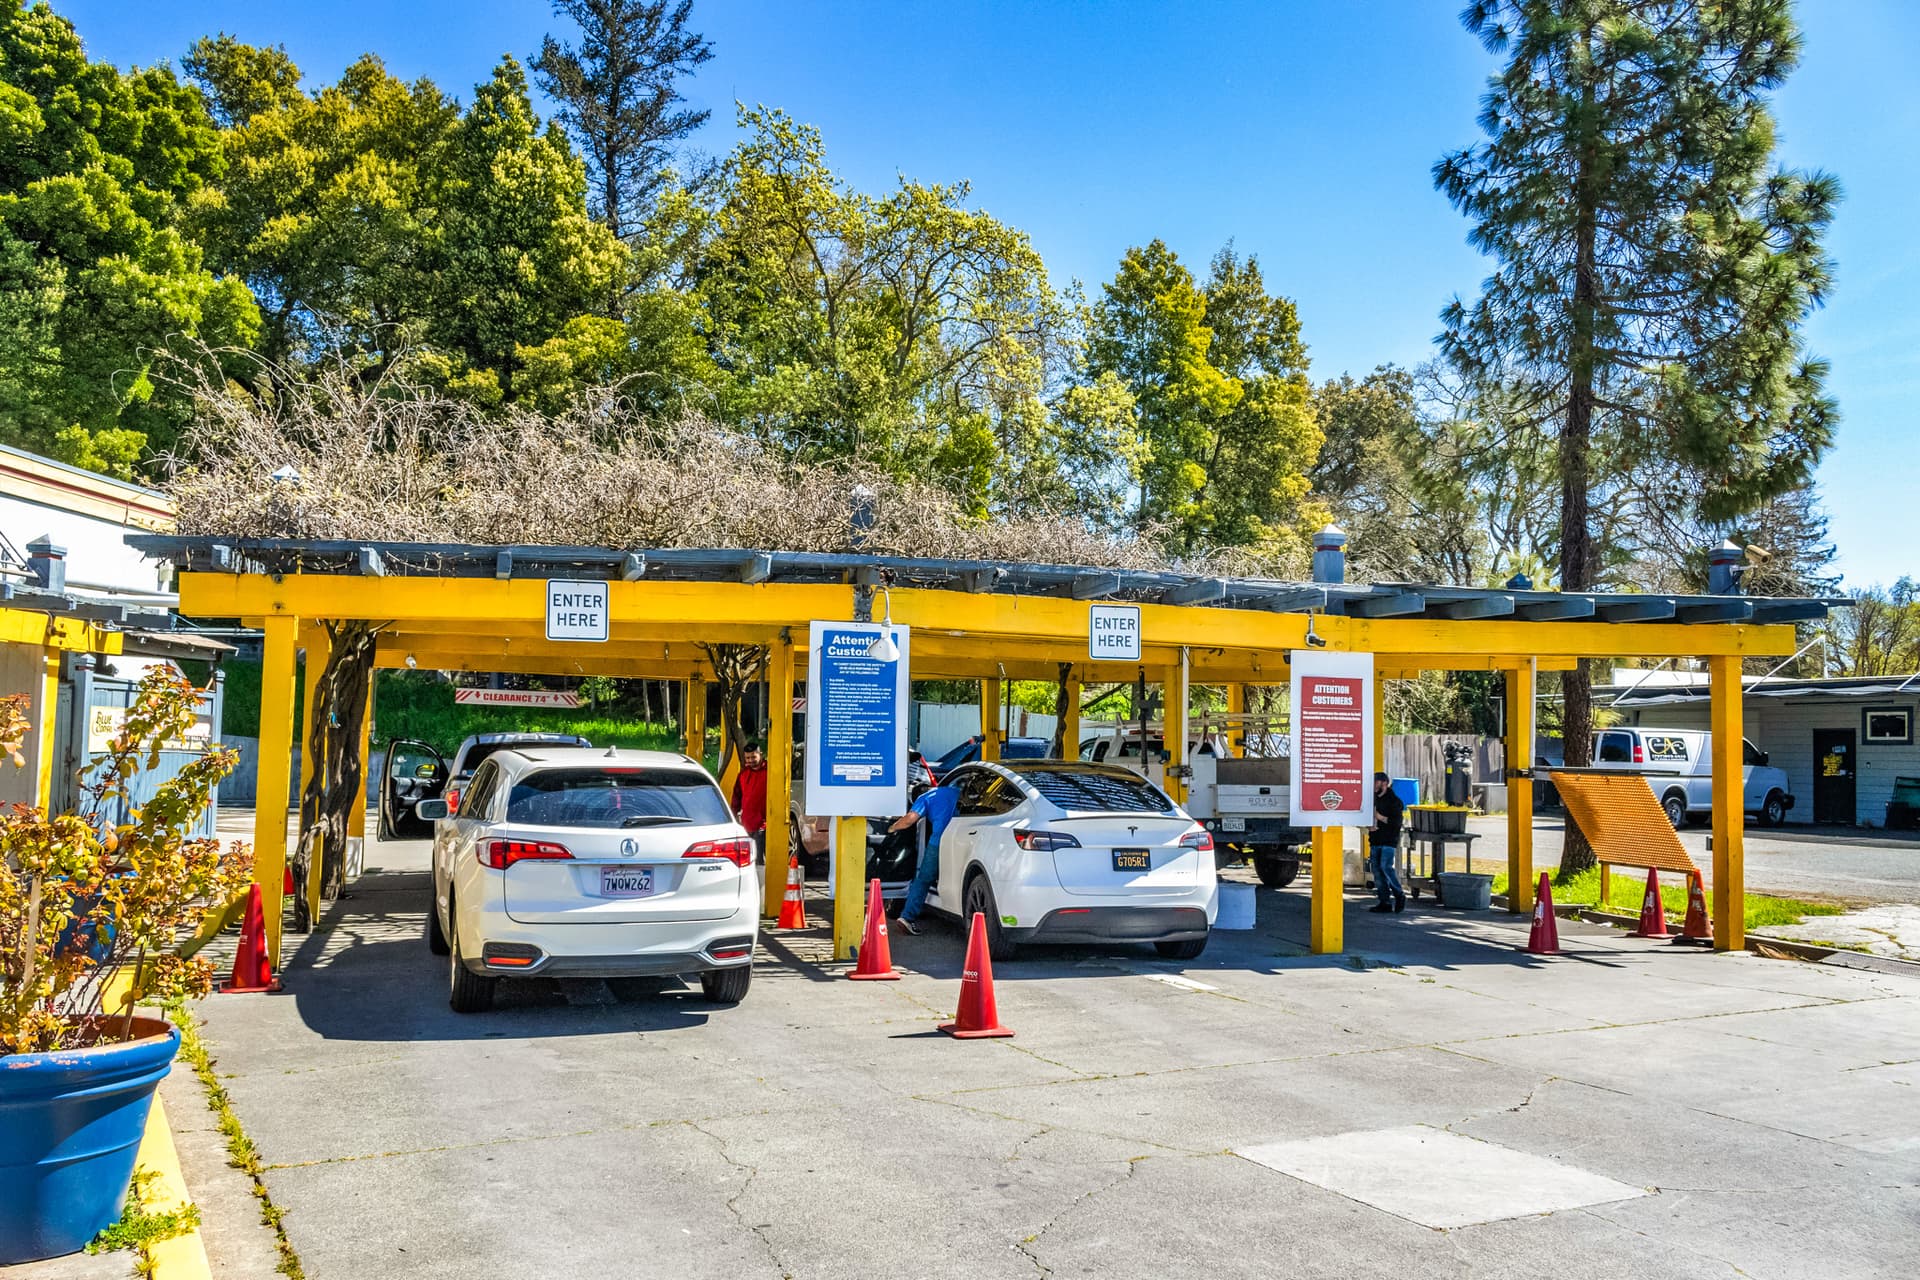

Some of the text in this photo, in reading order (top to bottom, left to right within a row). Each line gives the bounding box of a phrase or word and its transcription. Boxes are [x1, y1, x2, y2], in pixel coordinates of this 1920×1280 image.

[553, 593, 602, 608] ENTER
[557, 612, 598, 627] HERE
[1095, 617, 1136, 630] ENTER
[832, 635, 880, 646] Attenti
[1098, 634, 1132, 648] HERE
[827, 646, 871, 657] Custo
[1314, 684, 1350, 694] ATTENTION
[483, 692, 533, 703] CLEARANCE
[1312, 696, 1353, 706] CUSTOMERS
[1248, 797, 1280, 805] ROYAL
